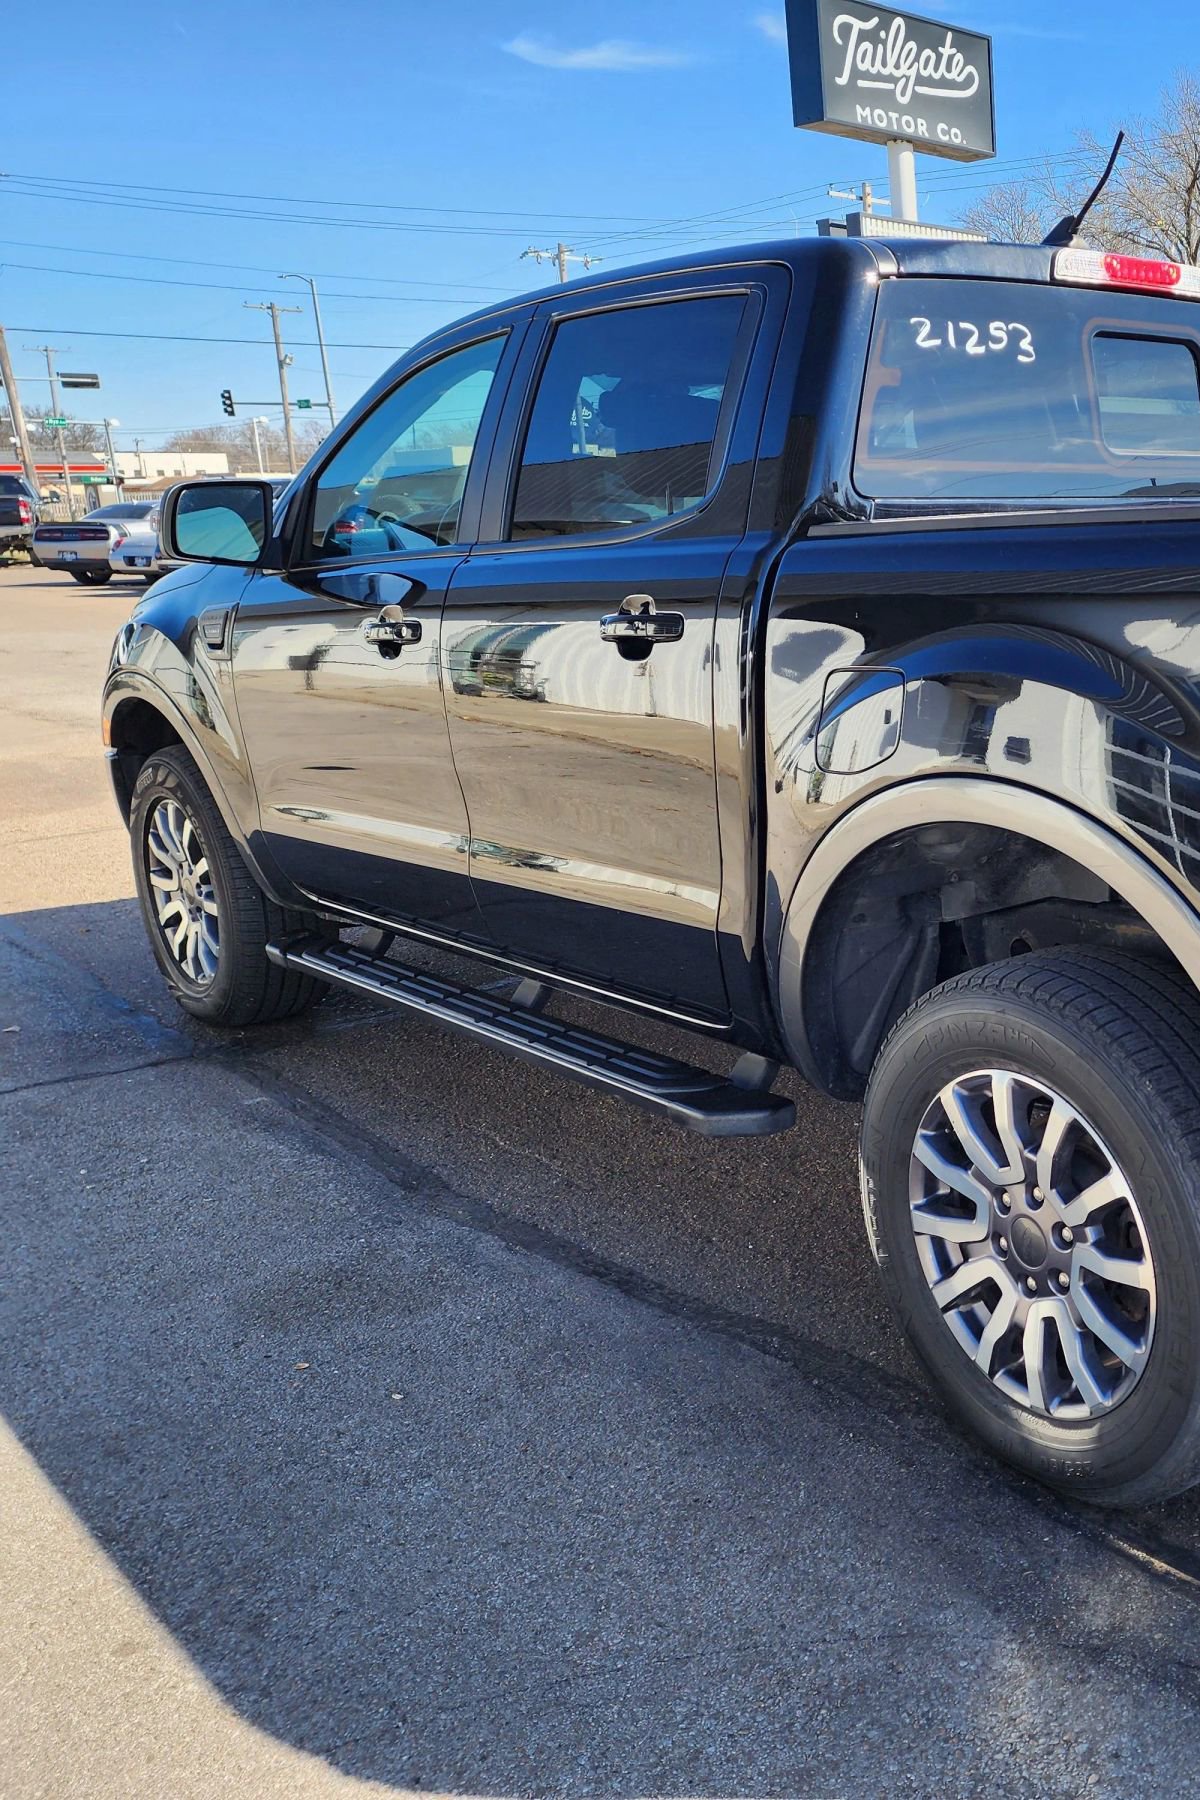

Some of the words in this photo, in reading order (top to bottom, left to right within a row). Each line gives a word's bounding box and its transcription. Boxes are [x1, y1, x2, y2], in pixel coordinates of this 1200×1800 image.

[833, 14, 980, 105] Tailgate
[856, 104, 929, 137] MOTOR
[936, 122, 967, 145] CO.
[909, 317, 1036, 363] 21253
